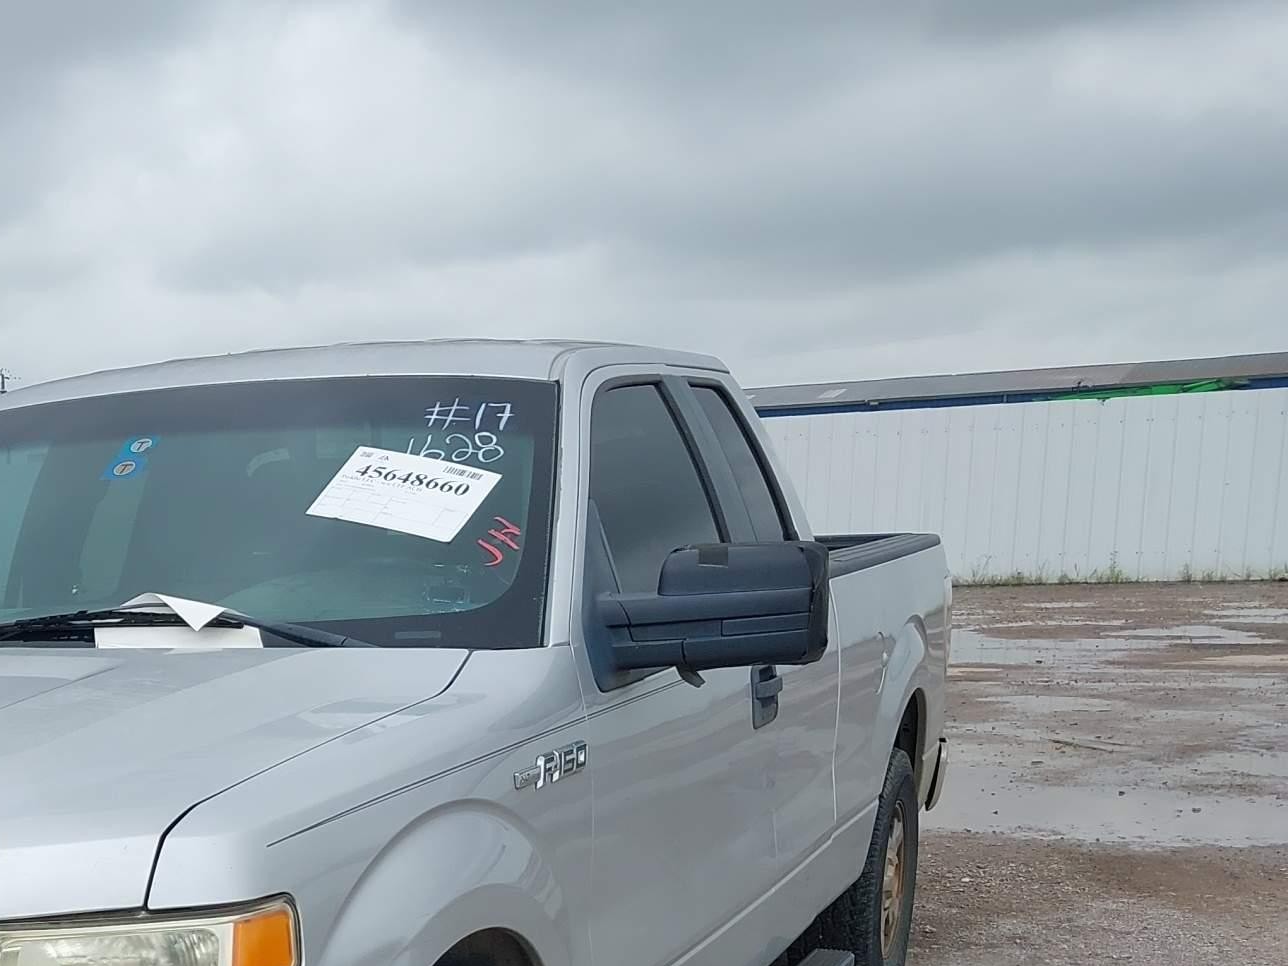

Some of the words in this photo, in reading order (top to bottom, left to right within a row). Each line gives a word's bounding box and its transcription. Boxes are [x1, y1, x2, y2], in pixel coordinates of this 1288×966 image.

[424, 397, 515, 431] #17
[405, 431, 505, 463] 1628
[354, 464, 471, 497] 45648660
